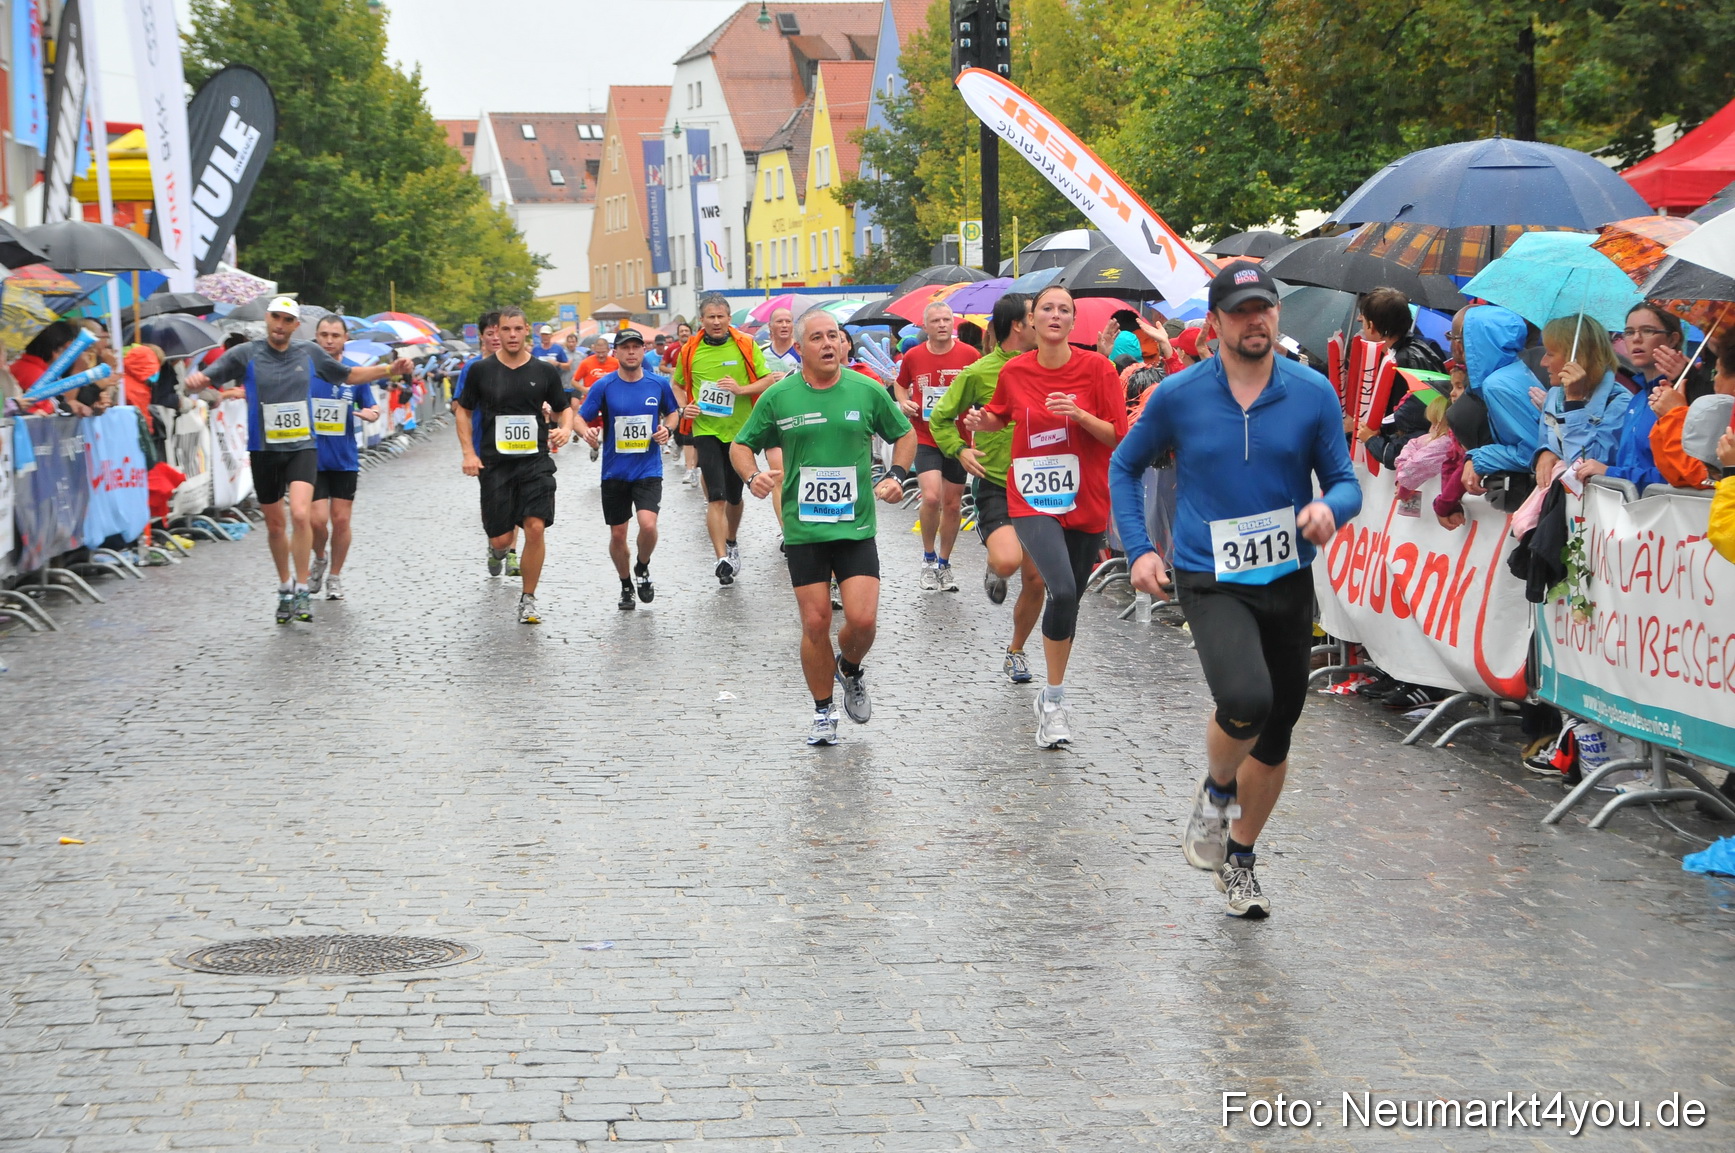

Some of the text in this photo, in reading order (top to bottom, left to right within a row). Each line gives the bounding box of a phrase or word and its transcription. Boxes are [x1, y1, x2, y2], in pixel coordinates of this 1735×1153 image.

[192, 110, 261, 261] HULE
[967, 226, 976, 237] H
[702, 389, 731, 406] 2461
[274, 412, 301, 428] 488
[314, 408, 339, 422] 424
[505, 425, 530, 440] 506
[622, 425, 647, 439] 484
[1021, 470, 1074, 494] 2364
[804, 481, 852, 503] 2634
[1033, 497, 1063, 506] Bettina
[813, 506, 844, 515] Andreas
[1222, 530, 1291, 570] 3413
